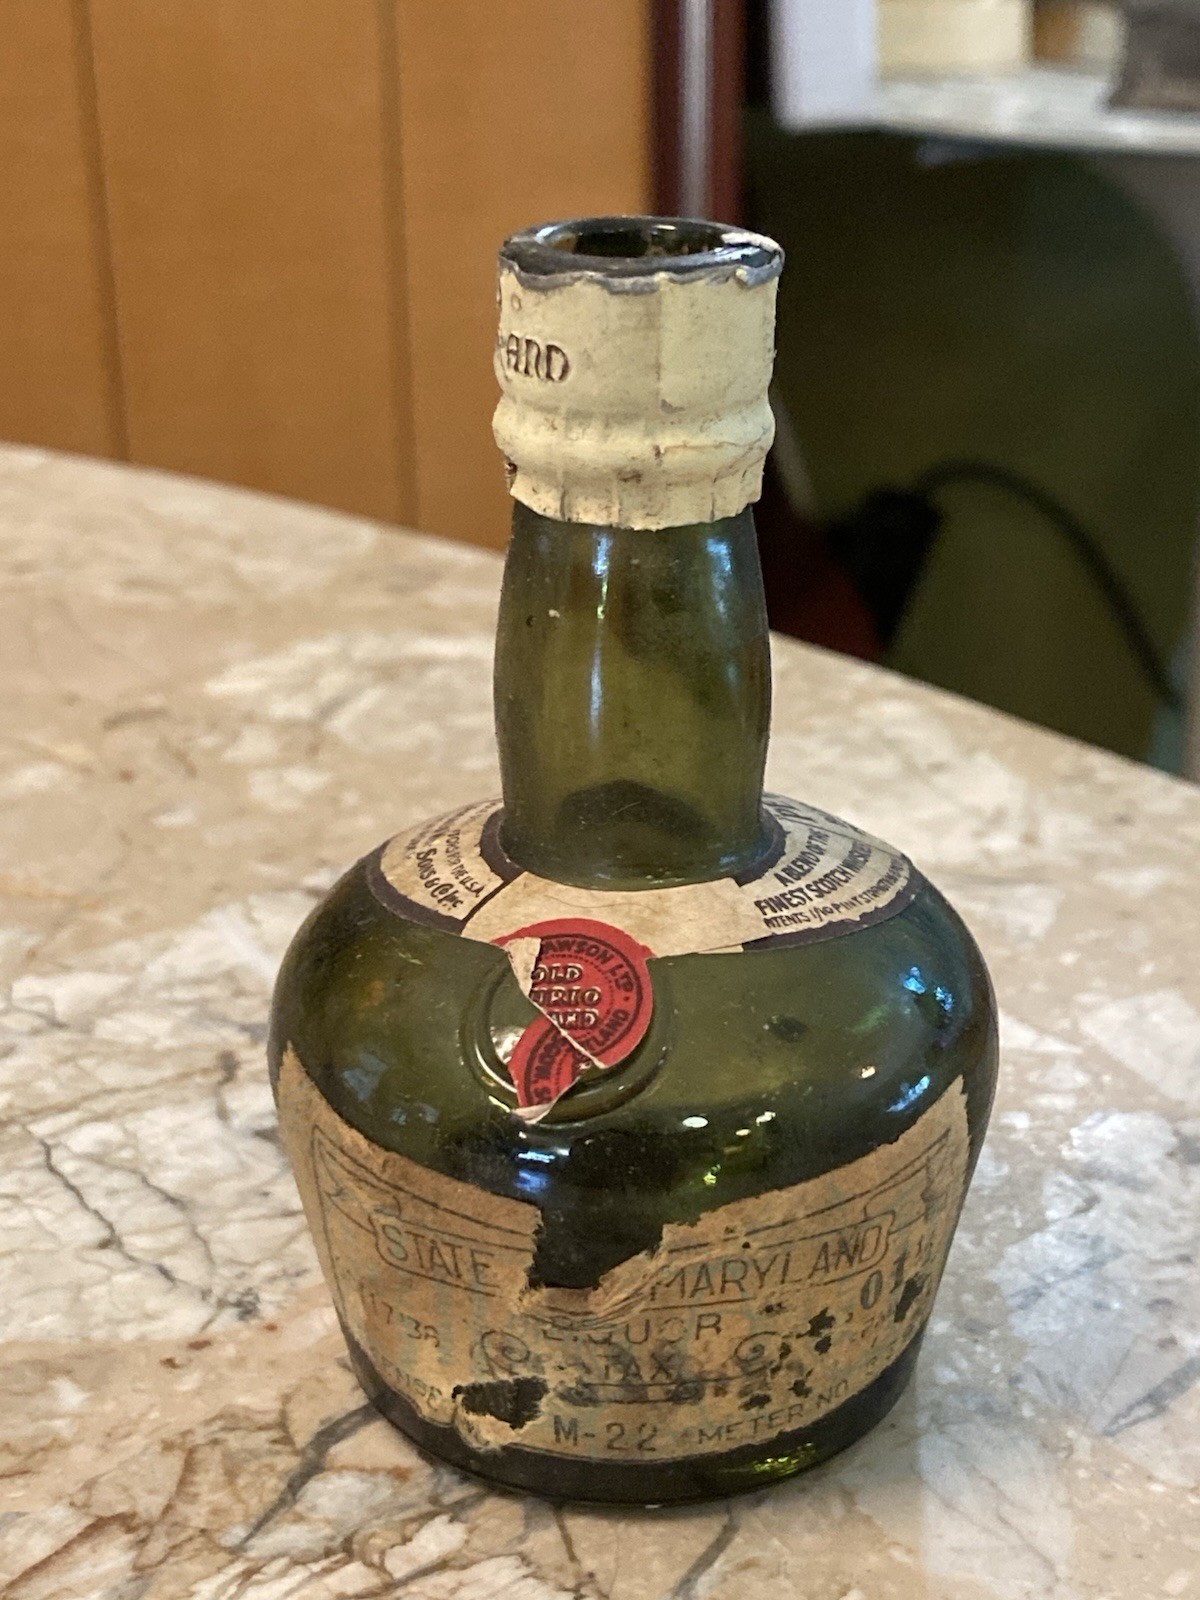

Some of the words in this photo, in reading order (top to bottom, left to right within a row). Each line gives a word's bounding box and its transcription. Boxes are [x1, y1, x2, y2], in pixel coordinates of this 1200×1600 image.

[499, 332, 570, 382] AND
[780, 850, 821, 881] BLEND
[753, 887, 814, 916] FINEST
[805, 863, 856, 899] SCOTCH
[382, 1223, 502, 1289] STATE
[648, 1224, 882, 1301] MARYLAND
[541, 1312, 723, 1345] LQUOR
[596, 1353, 675, 1382] TAX
[553, 1413, 658, 1451] M-22
[697, 1406, 804, 1445] METER
